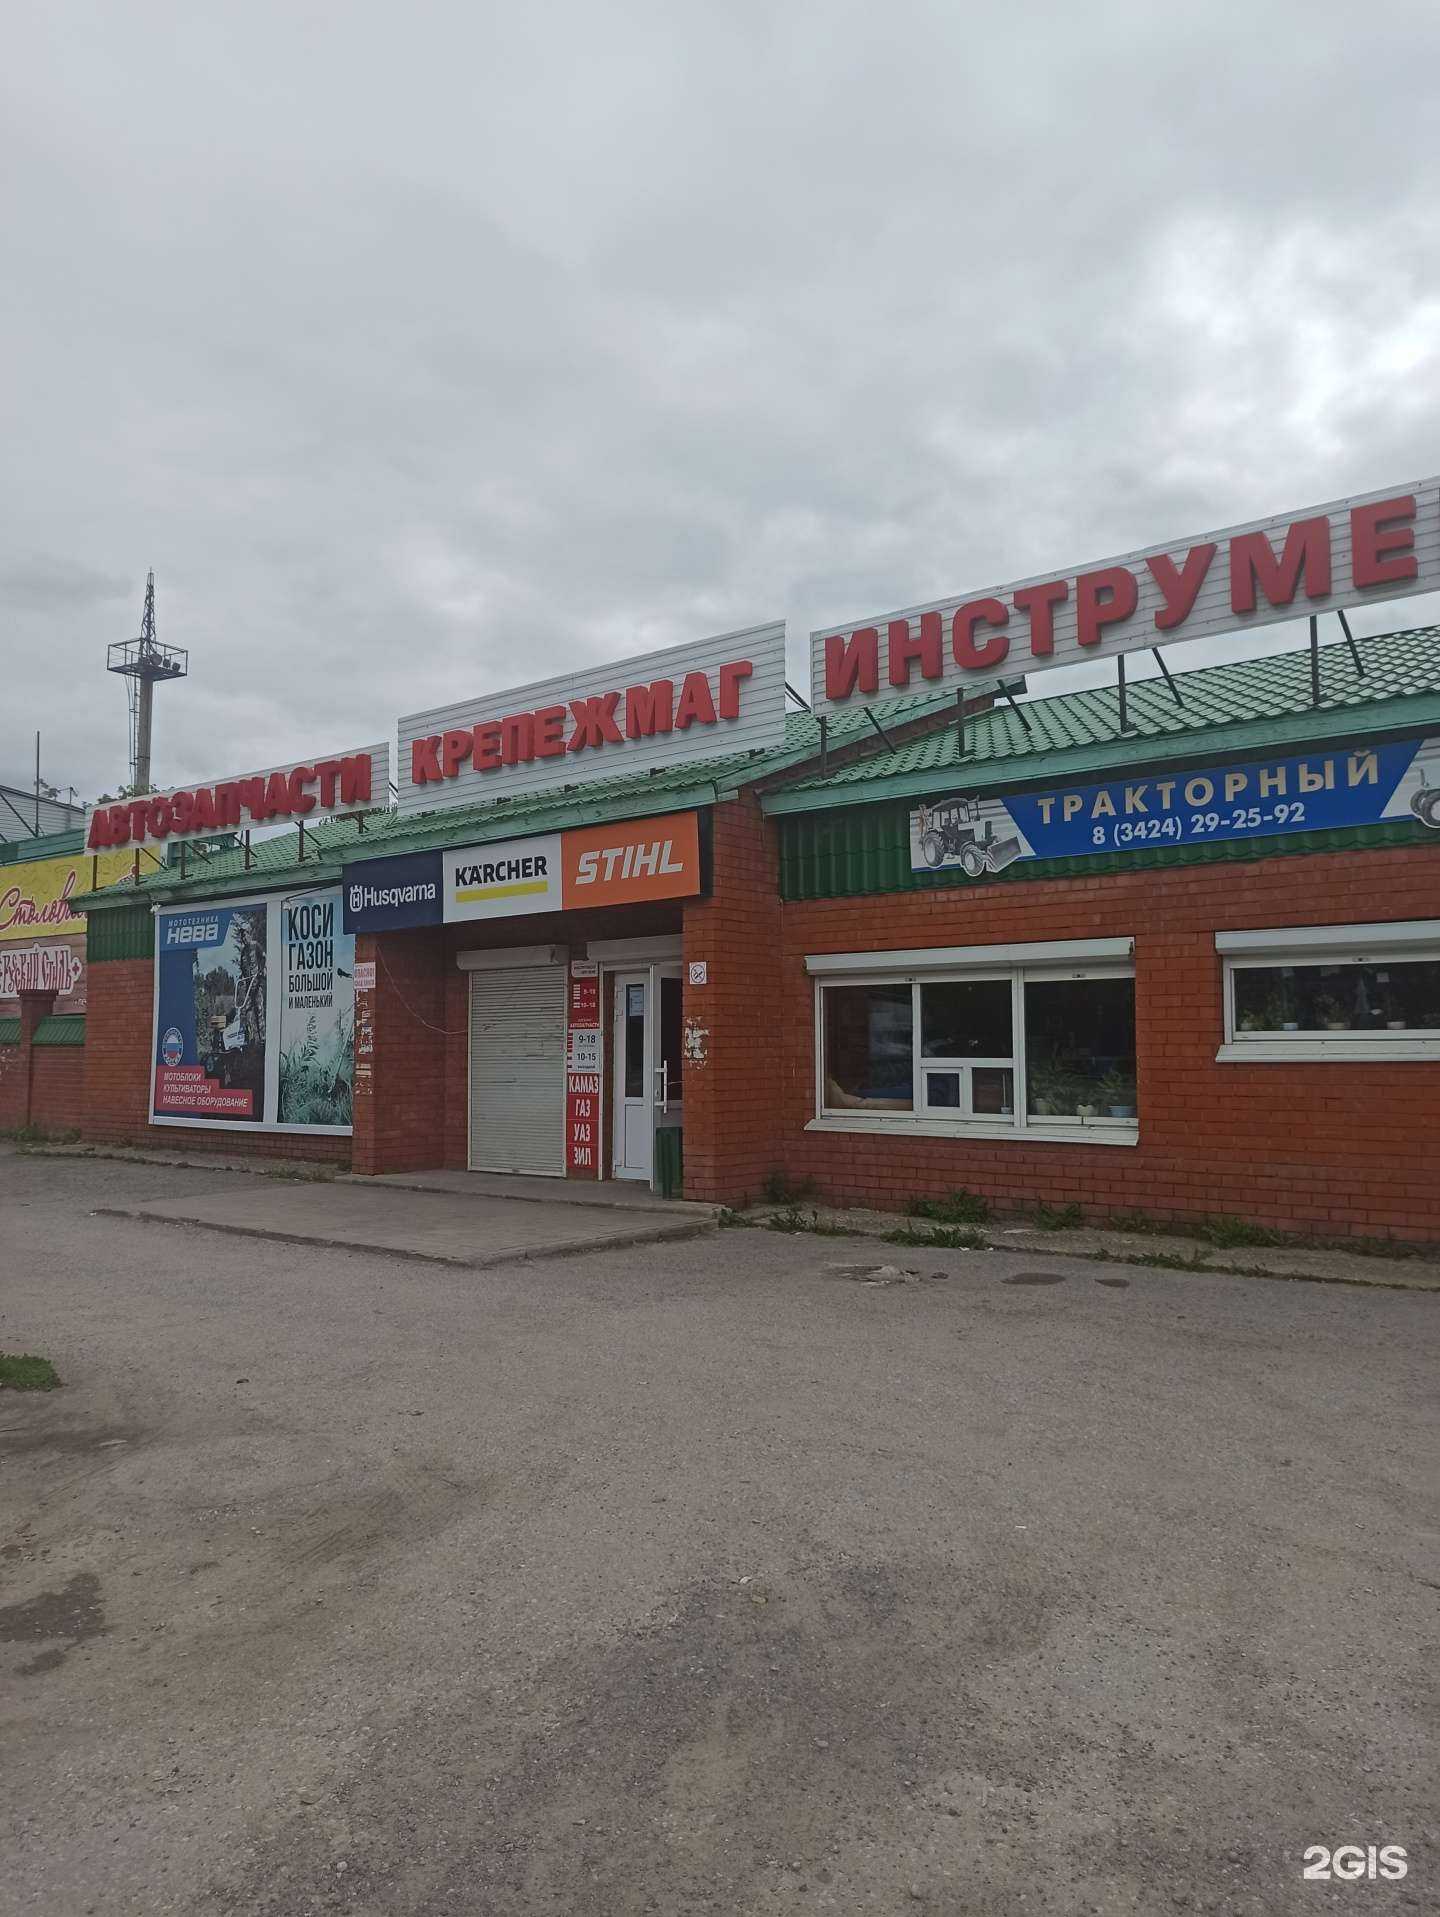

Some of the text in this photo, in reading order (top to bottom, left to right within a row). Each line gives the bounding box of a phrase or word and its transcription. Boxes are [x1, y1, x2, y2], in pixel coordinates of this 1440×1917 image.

[825, 495, 1419, 700] ИНСТРУМЕ
[411, 659, 753, 786] КРЕПЕЖМАГ
[1037, 749, 1379, 825] ТРАКТОРНЫЙ
[87, 753, 372, 849] АВТОЗАПЧАСТИ
[1092, 802, 1305, 847] 8 (3424) 29-25-92
[455, 856, 547, 887] KÄRCHER
[575, 840, 684, 885] STIHL
[364, 882, 436, 908] Husqvarna
[168, 915, 218, 927] МОТОТЕХНИКА
[288, 902, 334, 941] КОСИ
[288, 940, 333, 971] ГАЗОН
[288, 968, 333, 992] БОЛЬШОЙ
[288, 993, 333, 1009] И МАЛЕНЬКИЙ
[578, 1035, 596, 1044] 9-18
[577, 1053, 596, 1061] 10-15
[163, 1072, 201, 1081] МОТОБЛОКИ
[569, 1075, 599, 1094] КАМАЗ
[163, 1084, 211, 1094] КУЛЬТИВАТОРЫ
[162, 1095, 248, 1108] НАВЕСНОЕ ОБОРУДОВАНИЕ
[575, 1099, 591, 1117] ГАЗ
[574, 1123, 591, 1142] УАЗ
[573, 1147, 591, 1165] ЗИЛ
